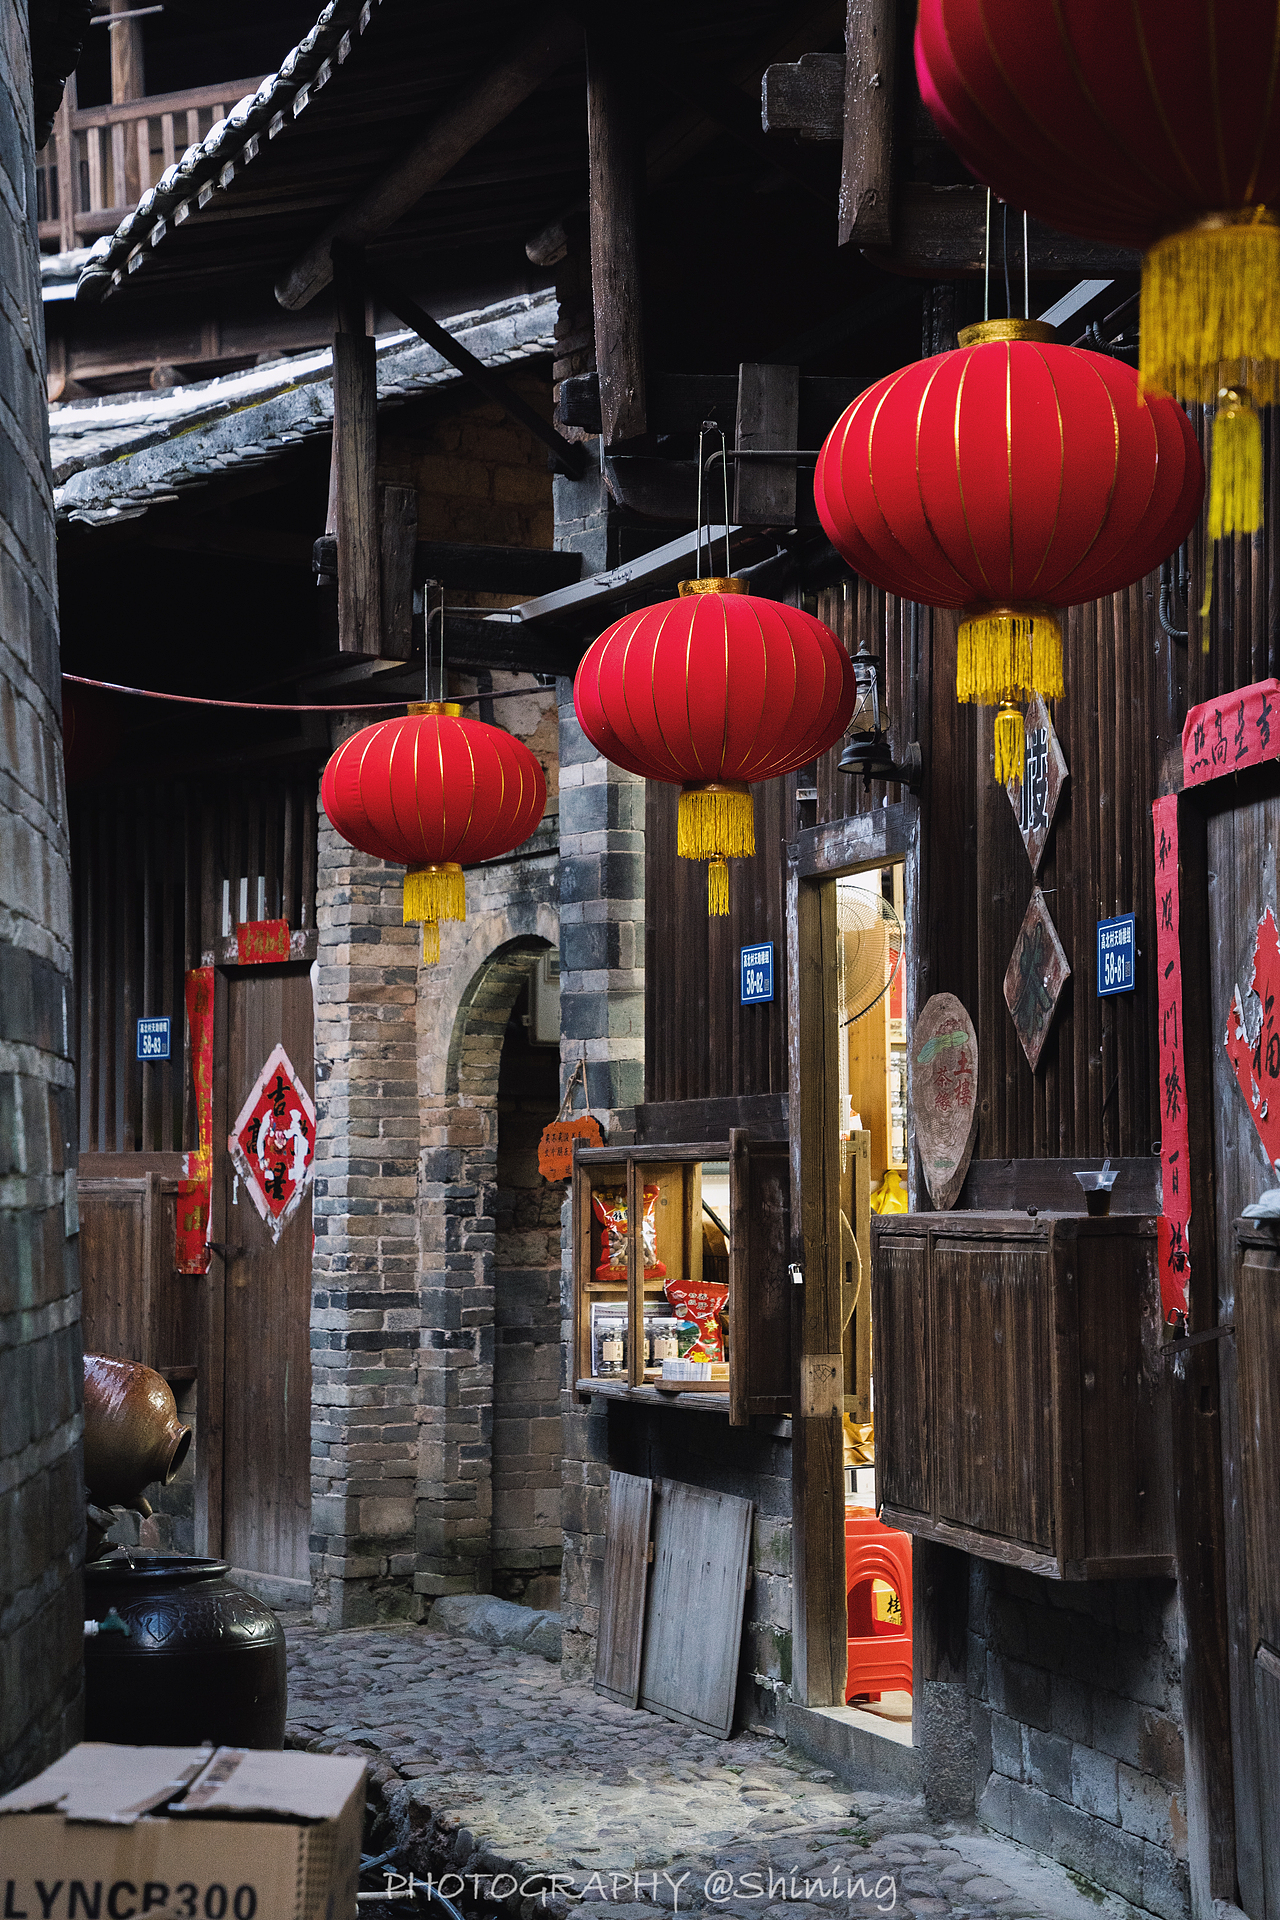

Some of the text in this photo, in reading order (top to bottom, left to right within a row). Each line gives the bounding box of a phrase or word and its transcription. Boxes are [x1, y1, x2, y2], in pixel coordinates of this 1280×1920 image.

[746, 968, 764, 996] 58-82
[1104, 952, 1126, 986] 58-81
[143, 1034, 162, 1054] 58-83
[266, 1075, 291, 1118] 吉
[933, 1065, 954, 1112] 茶緣
[953, 1050, 973, 1106] 土樓
[264, 1161, 286, 1201] 星
